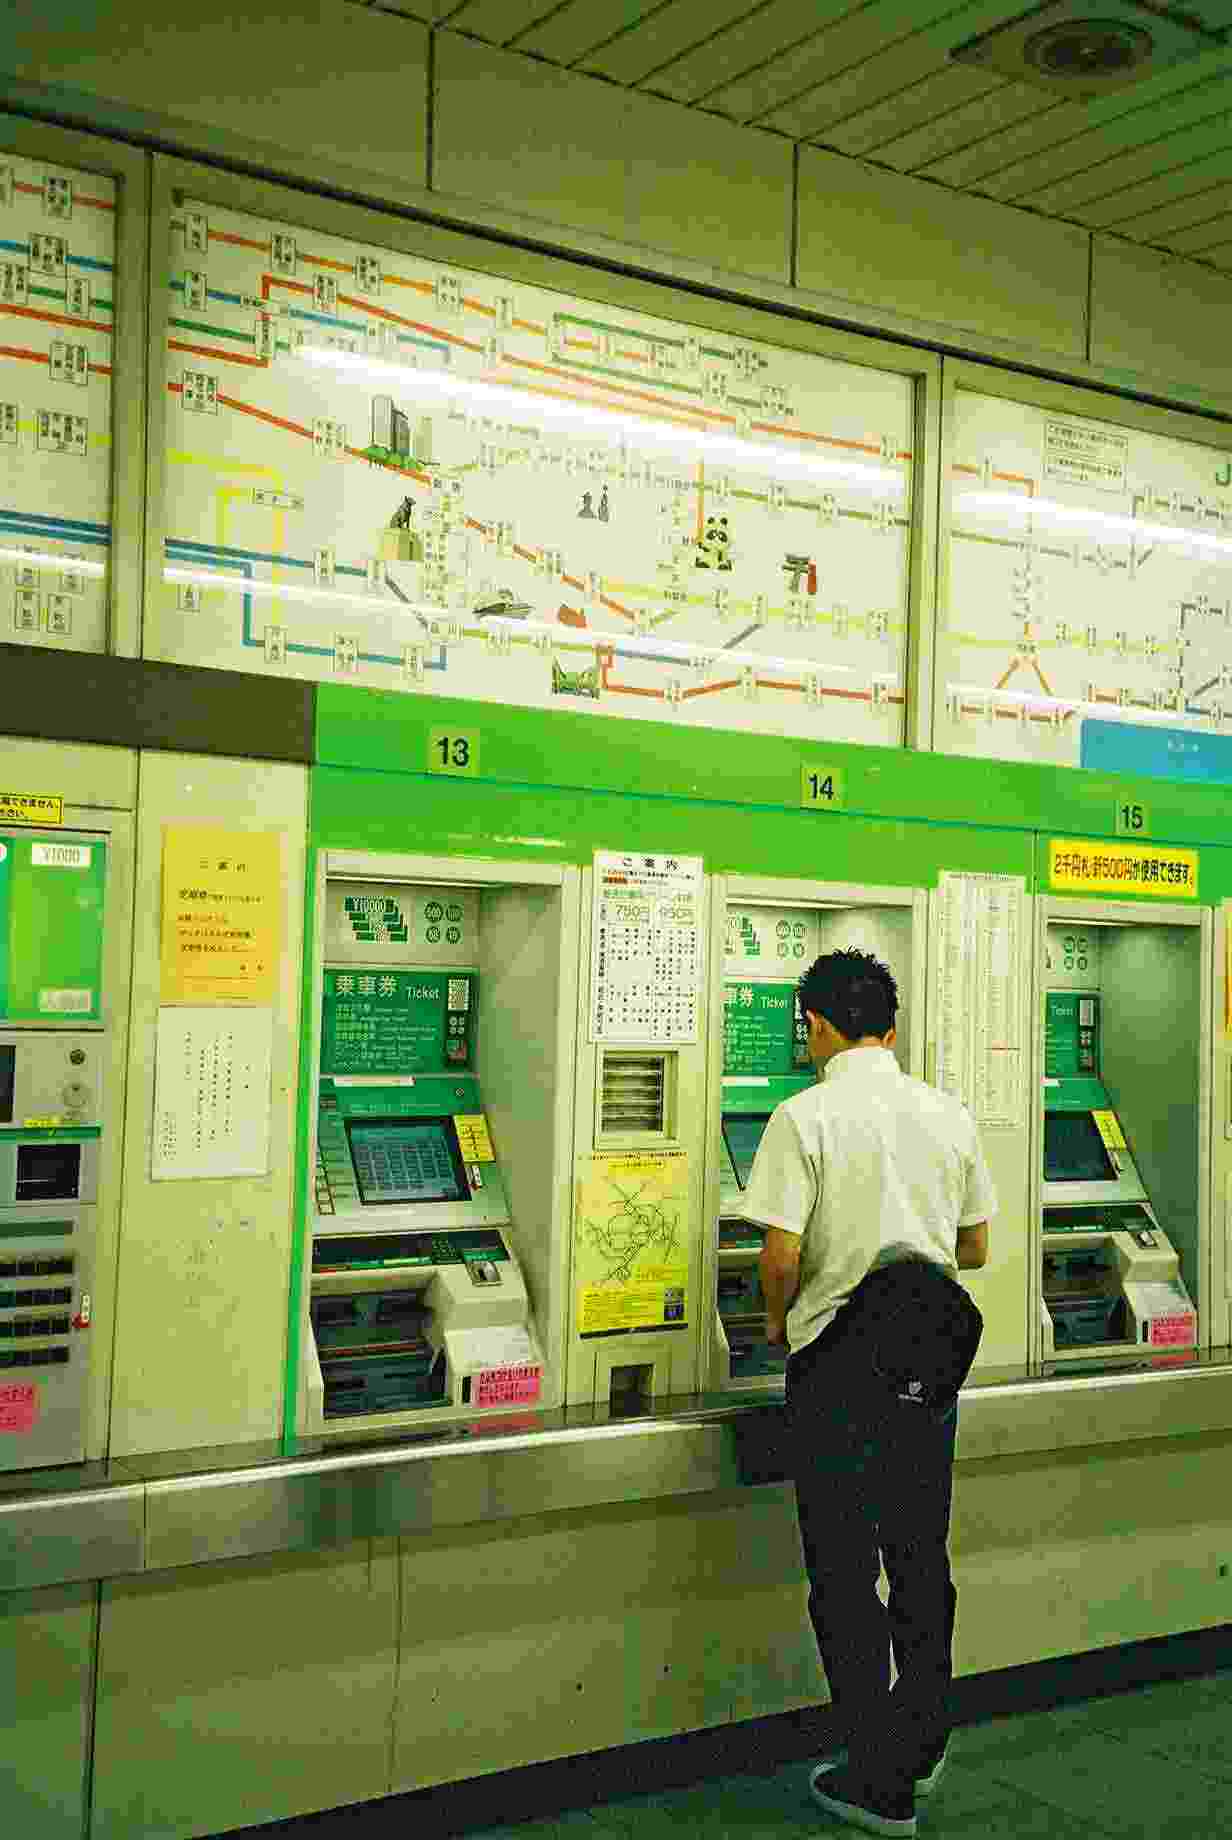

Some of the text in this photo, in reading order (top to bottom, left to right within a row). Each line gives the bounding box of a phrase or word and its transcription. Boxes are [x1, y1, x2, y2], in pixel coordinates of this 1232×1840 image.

[438, 737, 469, 766] 13
[809, 774, 835, 800] 14
[1121, 805, 1143, 829] 15
[335, 975, 440, 1000] 乗車券 Ticket
